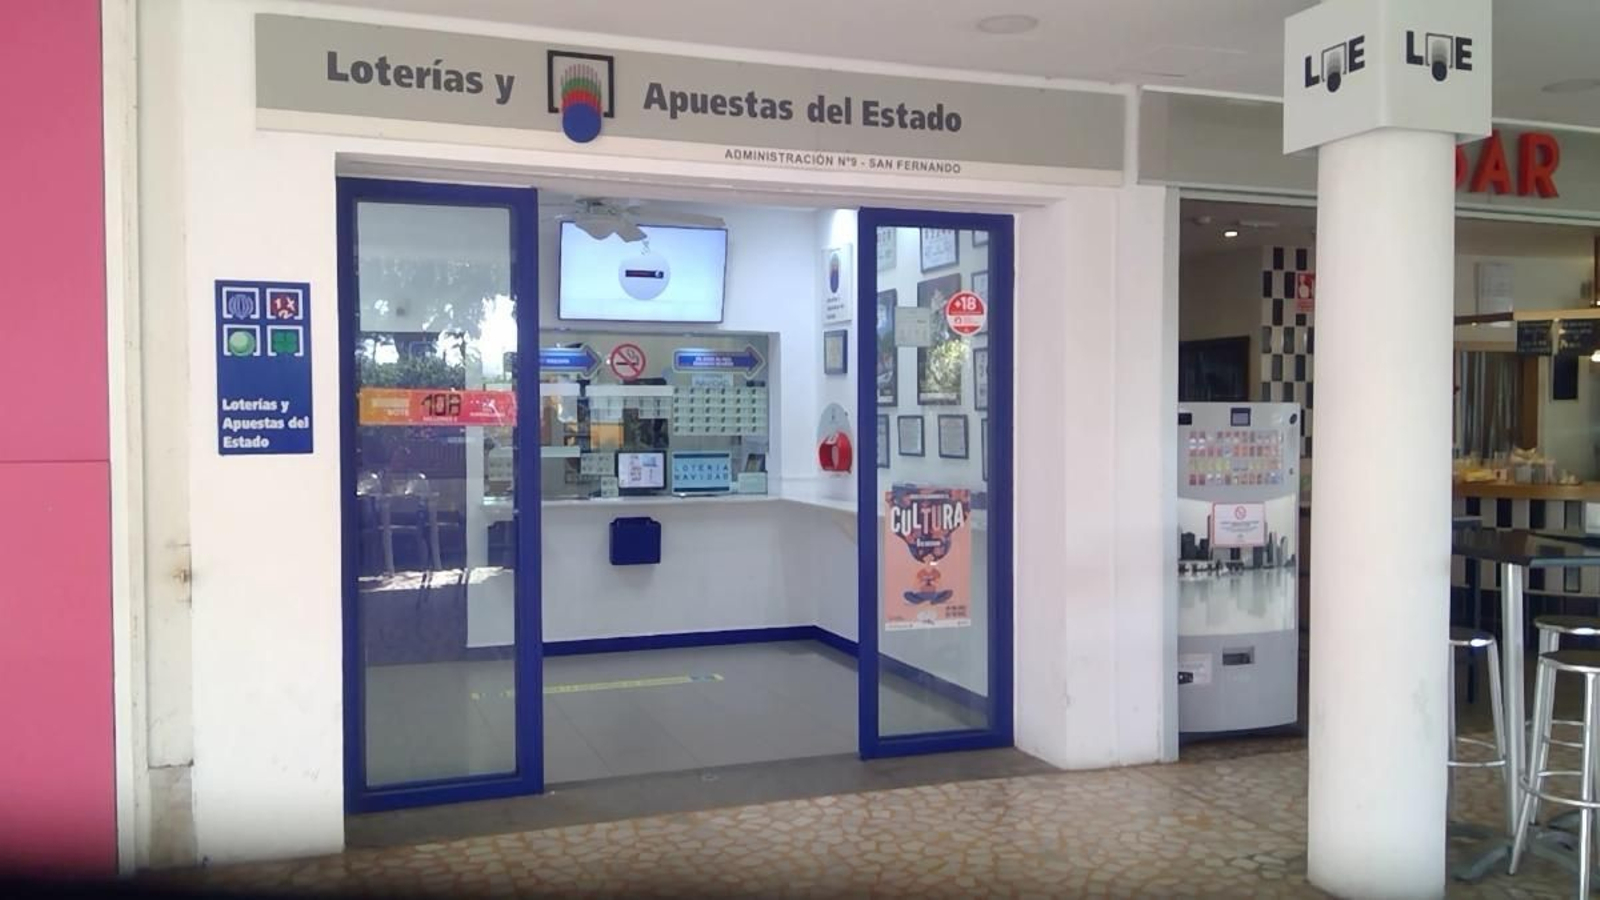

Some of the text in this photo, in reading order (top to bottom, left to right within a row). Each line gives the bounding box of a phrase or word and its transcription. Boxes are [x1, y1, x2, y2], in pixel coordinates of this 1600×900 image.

[327, 51, 962, 132] Loterías y Apuestas del Estado
[725, 148, 834, 167] ADMINISTRACIÓN
[869, 158, 893, 170] SAN
[897, 160, 962, 174] FERNANDO
[222, 398, 289, 413] Loterías y
[222, 416, 309, 432] Apuestas del
[223, 436, 269, 448] Estado
[891, 501, 965, 536] CULTURA
